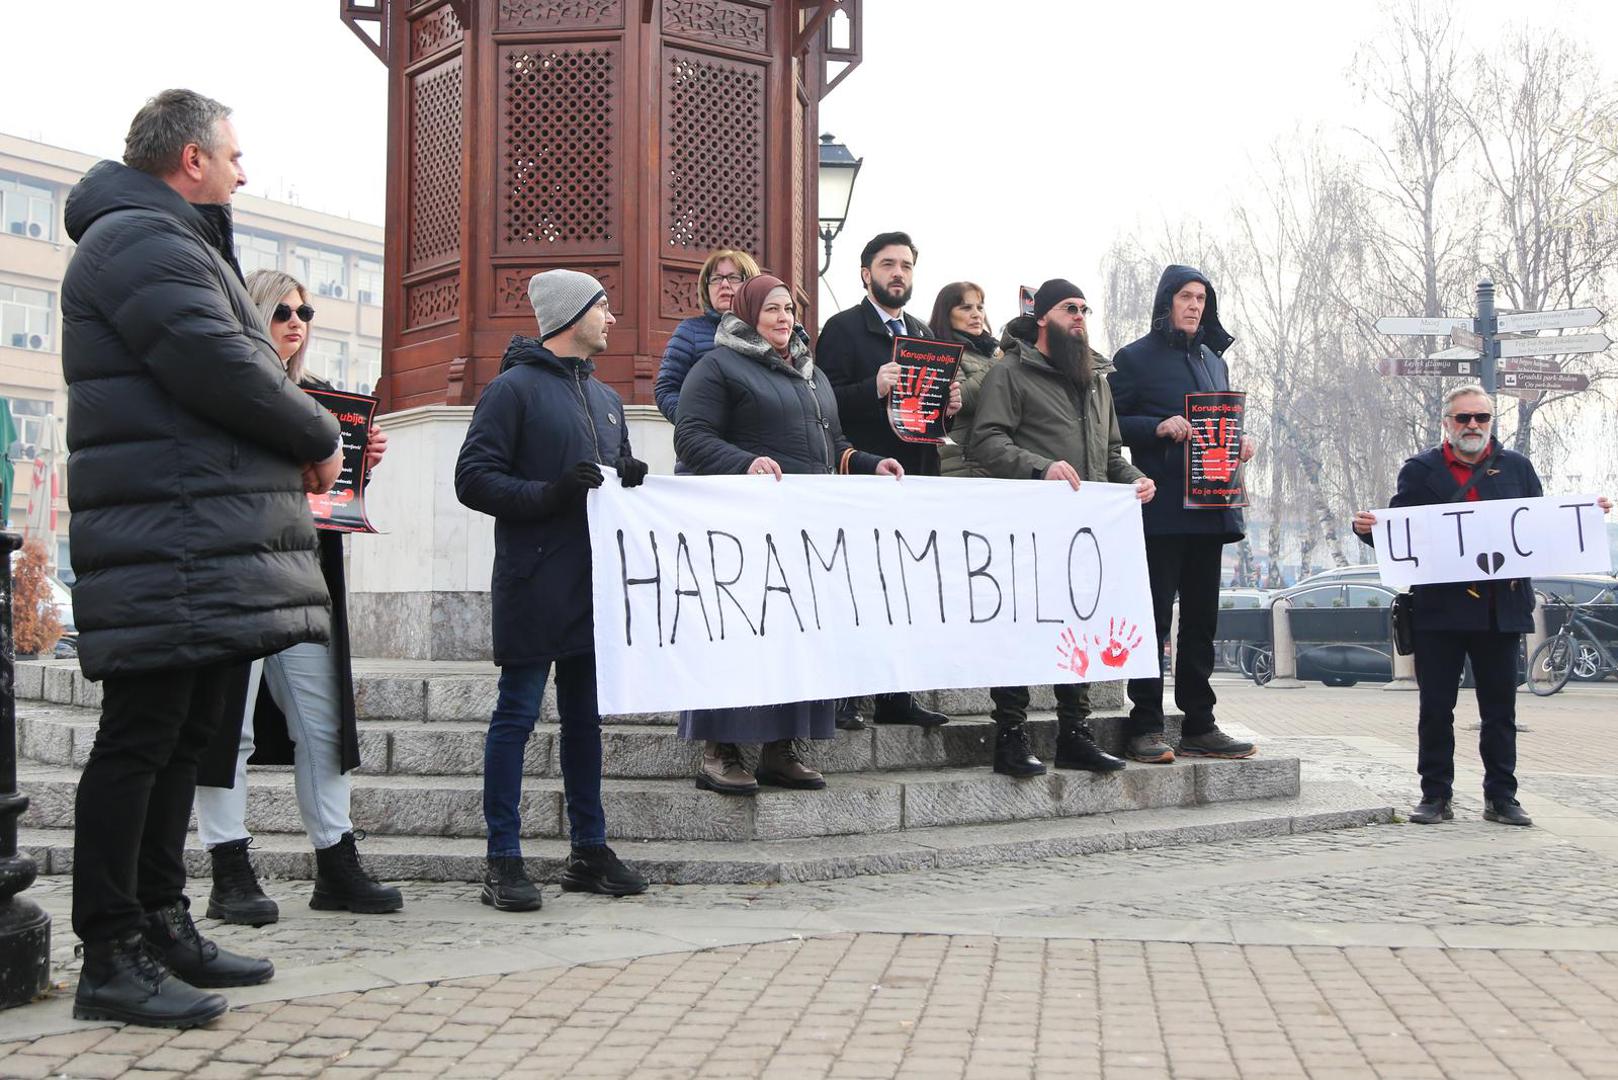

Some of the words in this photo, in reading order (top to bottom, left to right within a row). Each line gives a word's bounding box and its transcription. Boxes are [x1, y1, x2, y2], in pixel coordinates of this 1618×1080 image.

[900, 350, 937, 361] Korupcija
[1518, 372, 1542, 381] Gradski
[1192, 405, 1231, 414] Korupcija
[340, 412, 365, 426] ubija.
[1203, 488, 1213, 496] je
[962, 527, 1102, 625] BILO
